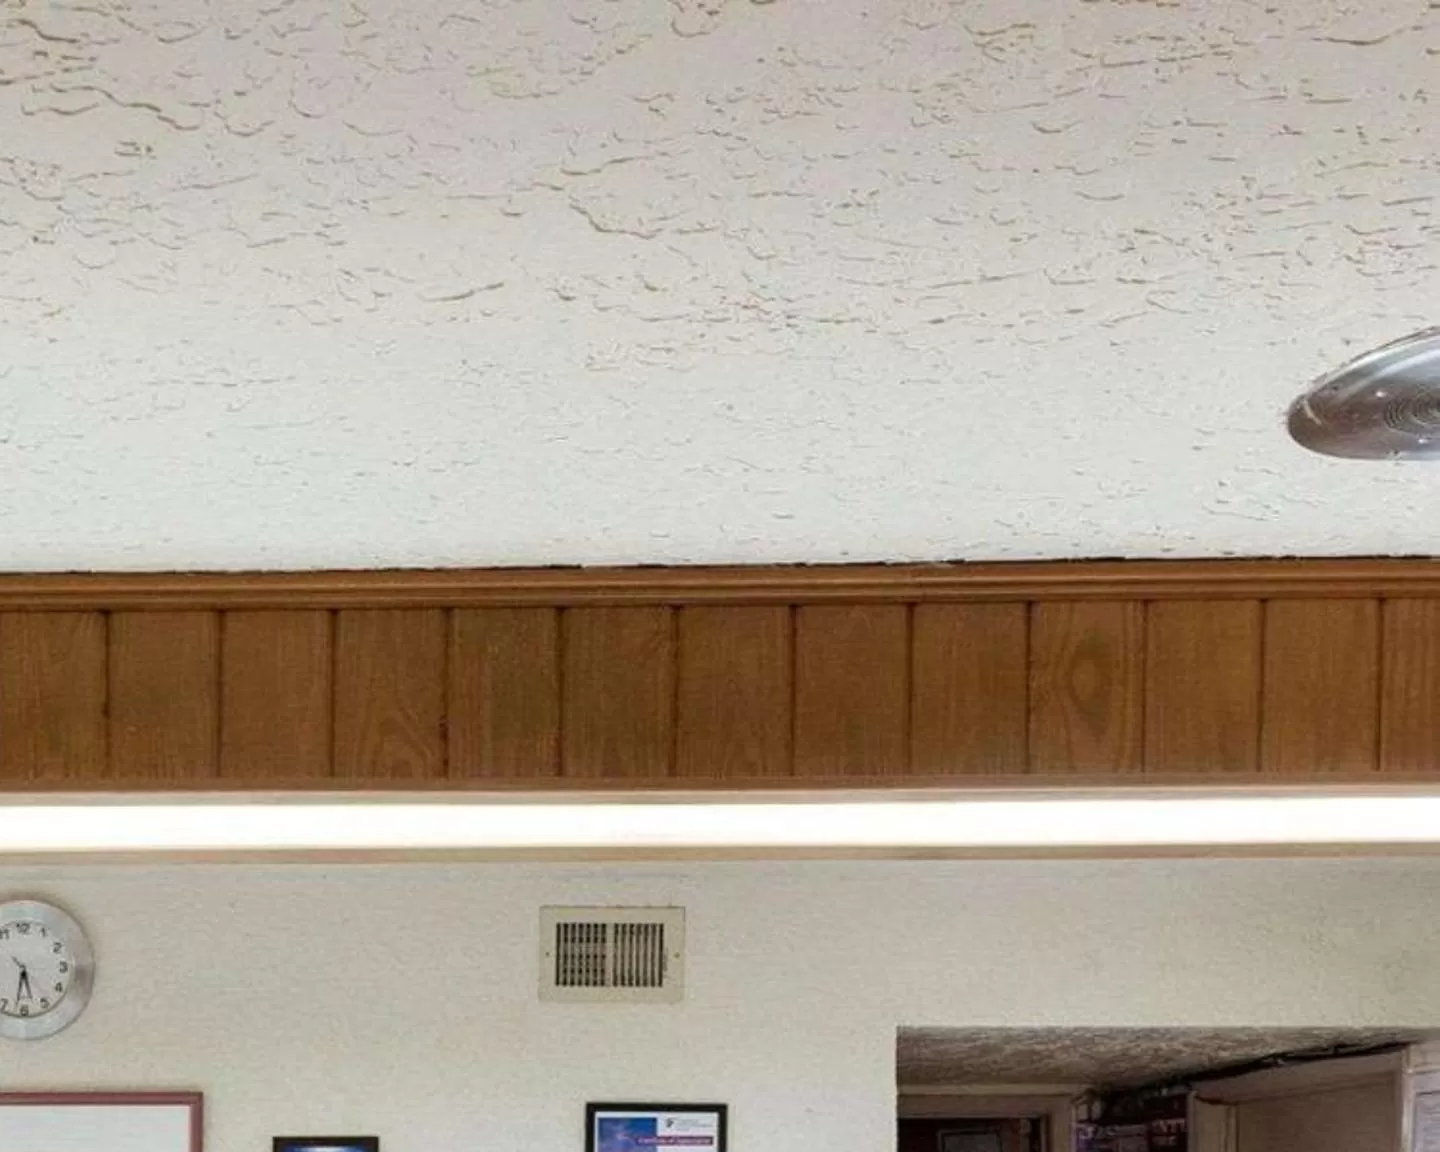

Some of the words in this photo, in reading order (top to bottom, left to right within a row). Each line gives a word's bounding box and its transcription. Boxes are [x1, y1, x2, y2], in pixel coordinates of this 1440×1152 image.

[16, 922, 31, 935] 12
[41, 926, 48, 938] 1
[52, 941, 62, 954] 2
[58, 960, 68, 974] 3
[54, 981, 63, 993] 4
[0, 998, 9, 1012] 7
[40, 997, 50, 1010] 5
[19, 1004, 29, 1017] 6
